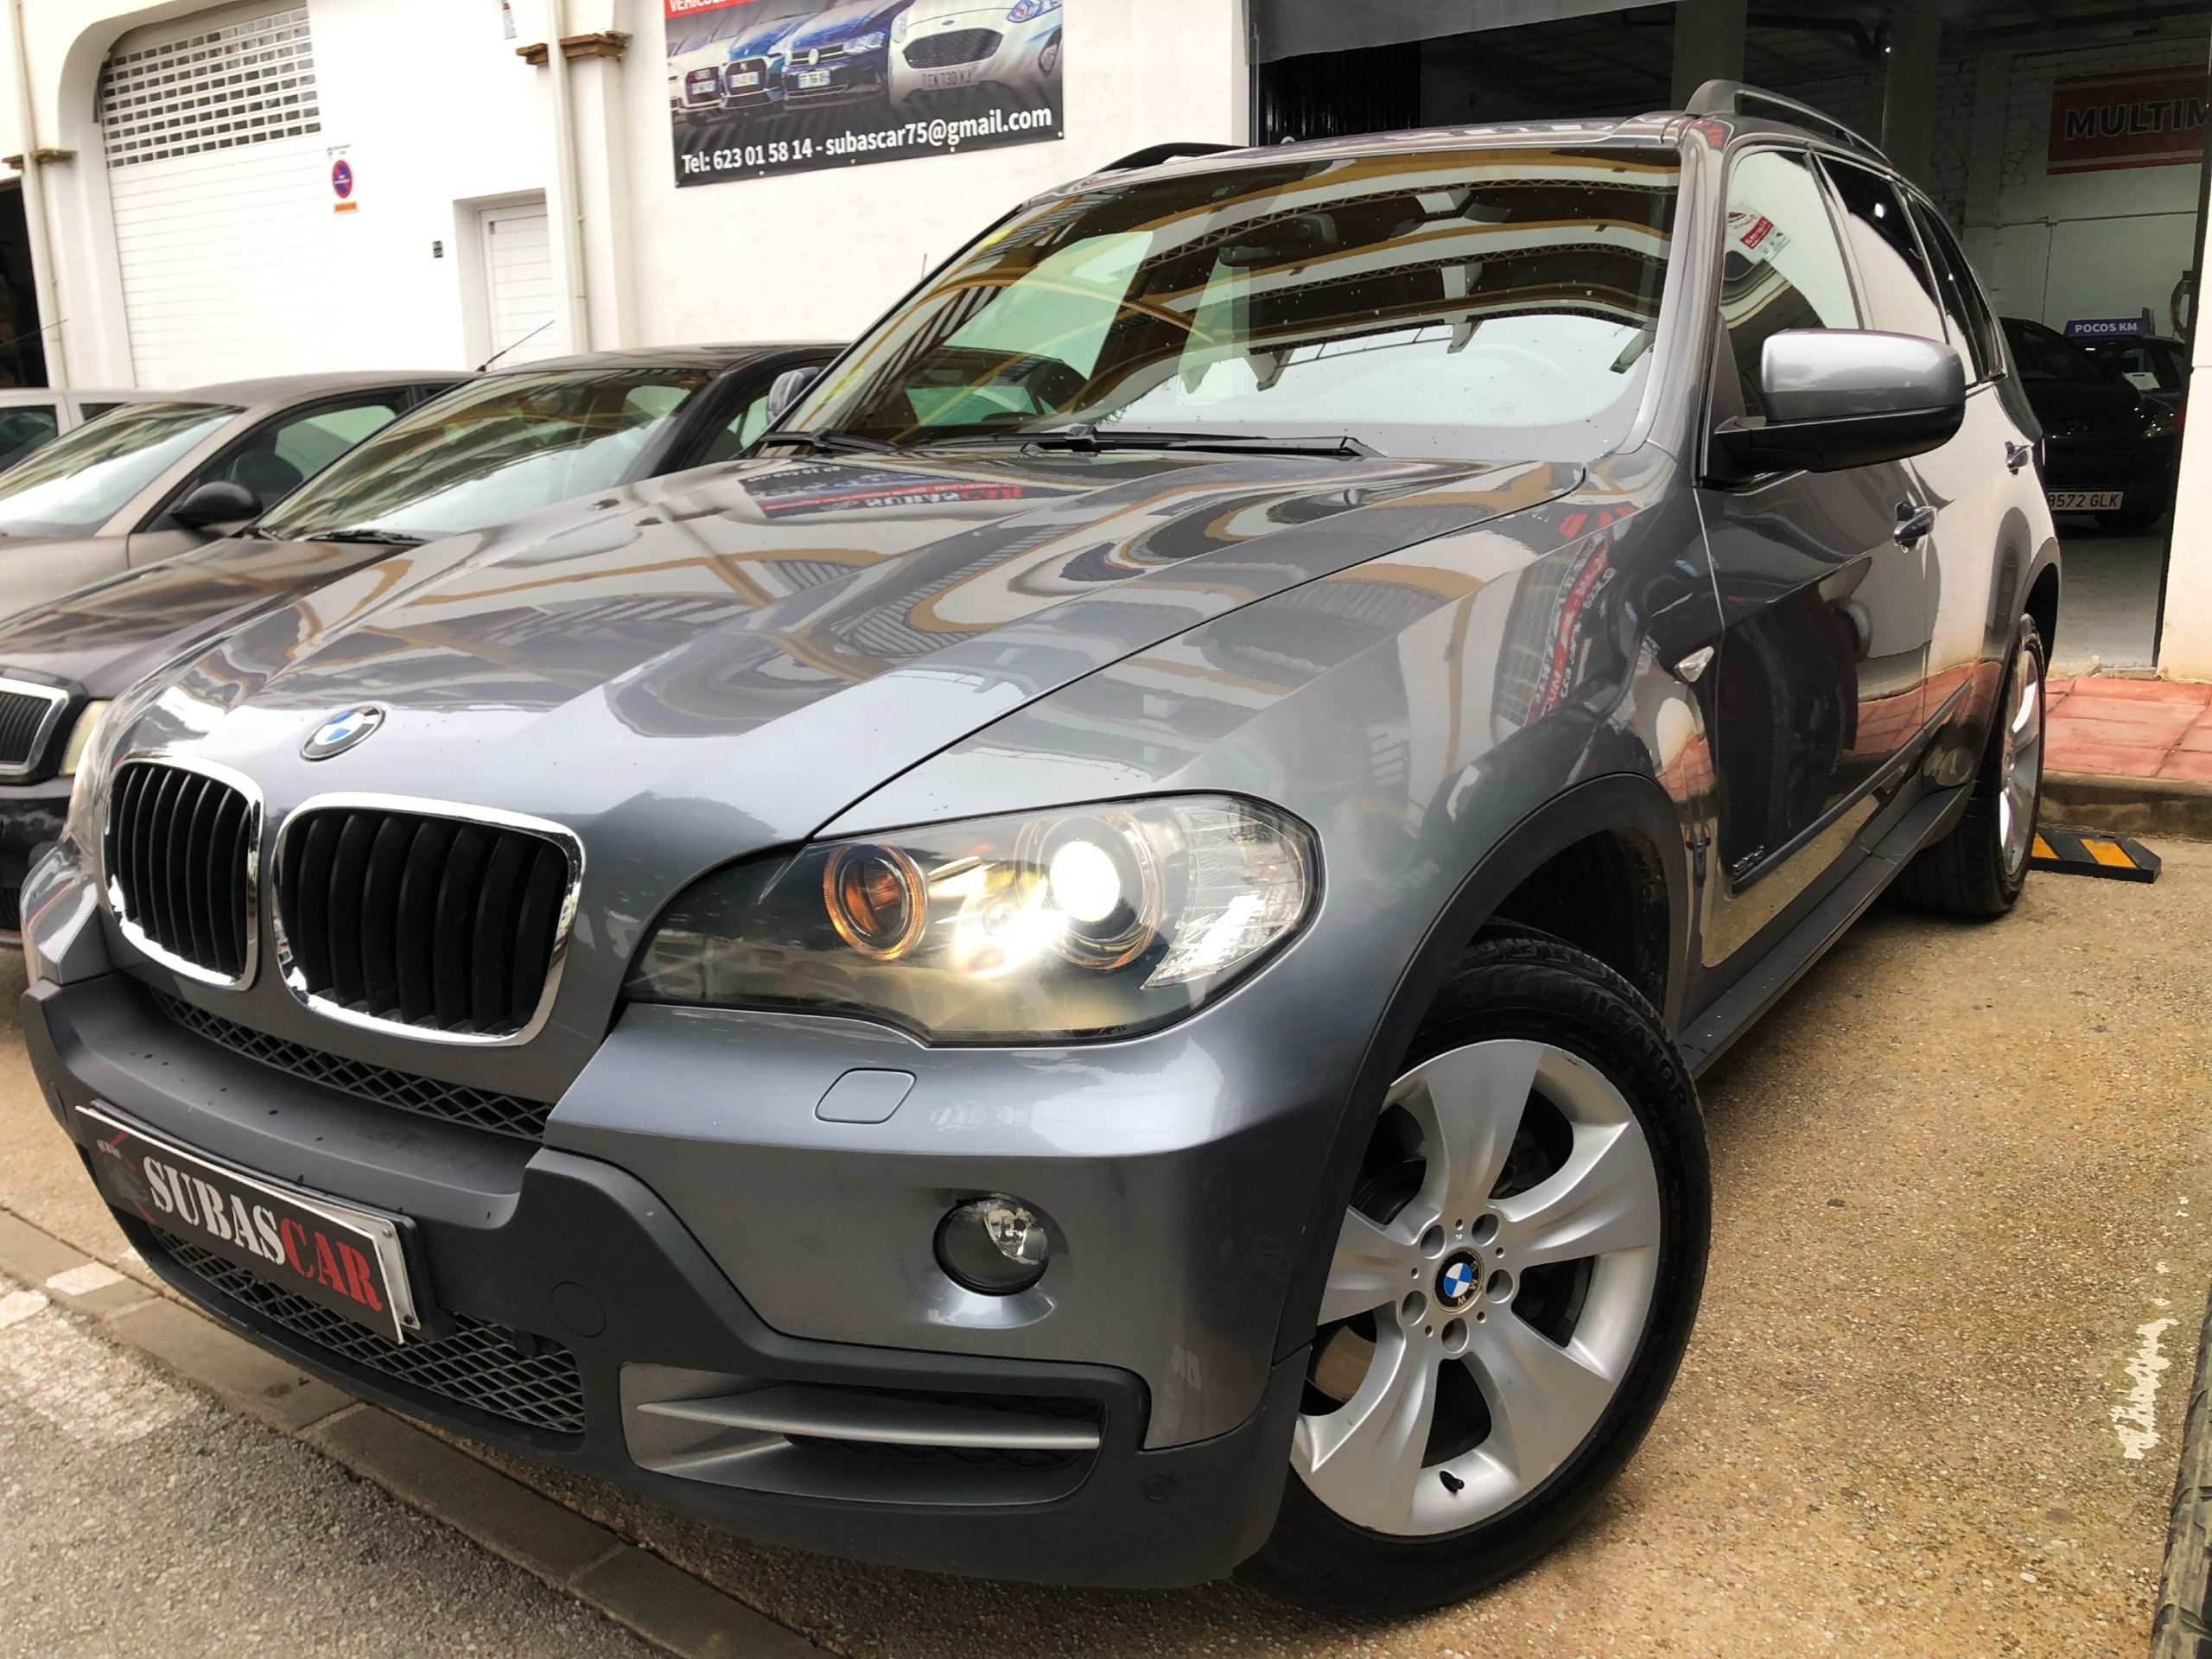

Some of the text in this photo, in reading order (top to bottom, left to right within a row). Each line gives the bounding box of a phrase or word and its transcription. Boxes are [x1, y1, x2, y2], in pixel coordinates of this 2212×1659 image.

[681, 151, 711, 174] Tel:
[713, 148, 742, 170] 623
[745, 145, 766, 166] 01
[768, 141, 790, 162] 58
[792, 138, 813, 160] 14
[825, 107, 1052, 156] subascar75@gmail.com
[2075, 322, 2138, 334] POCOS KM
[2090, 494, 2120, 507] GLK
[143, 1155, 382, 1313] SUBASCAR
